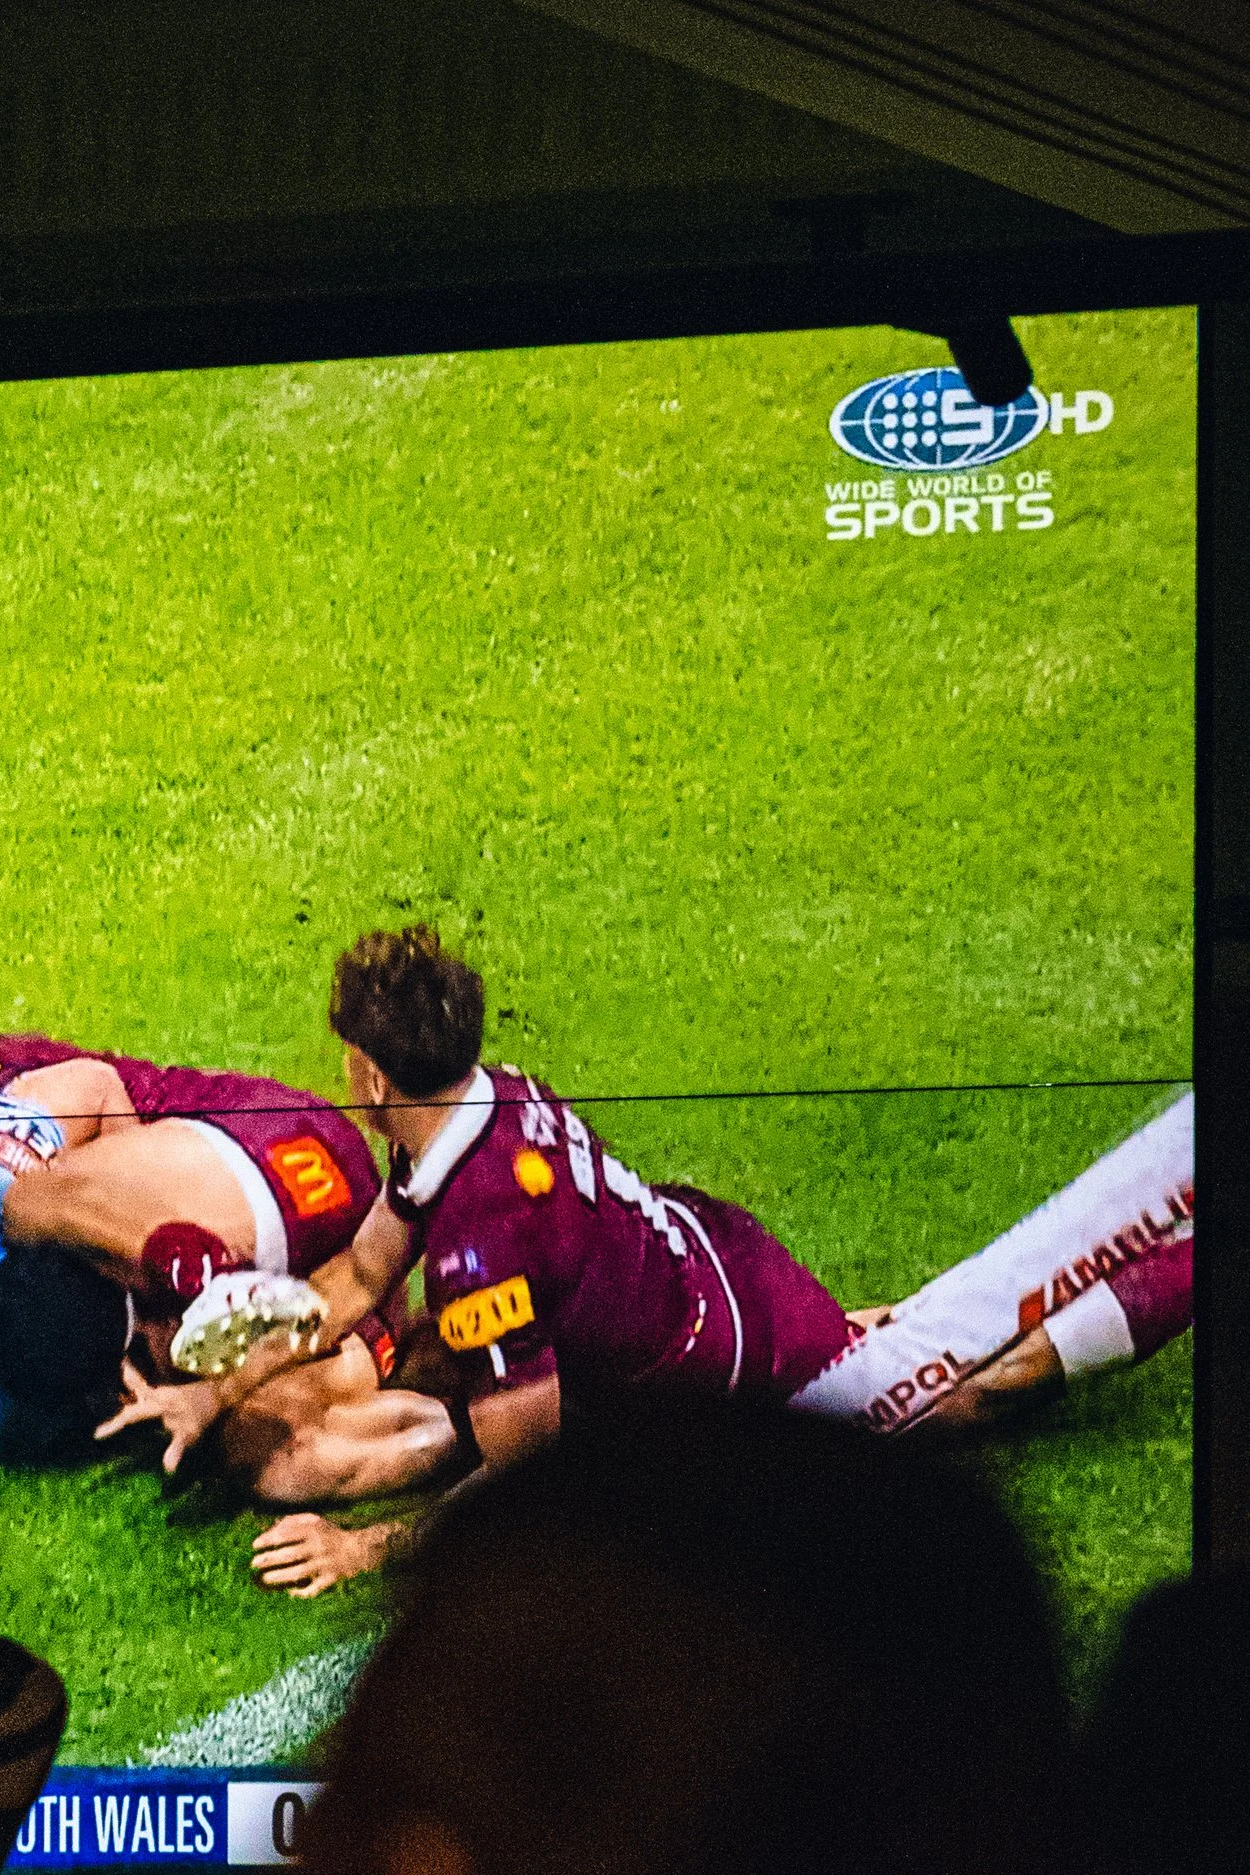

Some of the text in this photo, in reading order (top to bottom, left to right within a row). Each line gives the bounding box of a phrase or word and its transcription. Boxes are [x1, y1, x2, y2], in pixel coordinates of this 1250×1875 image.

[1049, 389, 1114, 435] HD
[825, 470, 1053, 502] WIDE WORLD OF
[824, 492, 1055, 541] SPORTS
[93, 1795, 215, 1853] WALES
[272, 1792, 306, 1857] 0
